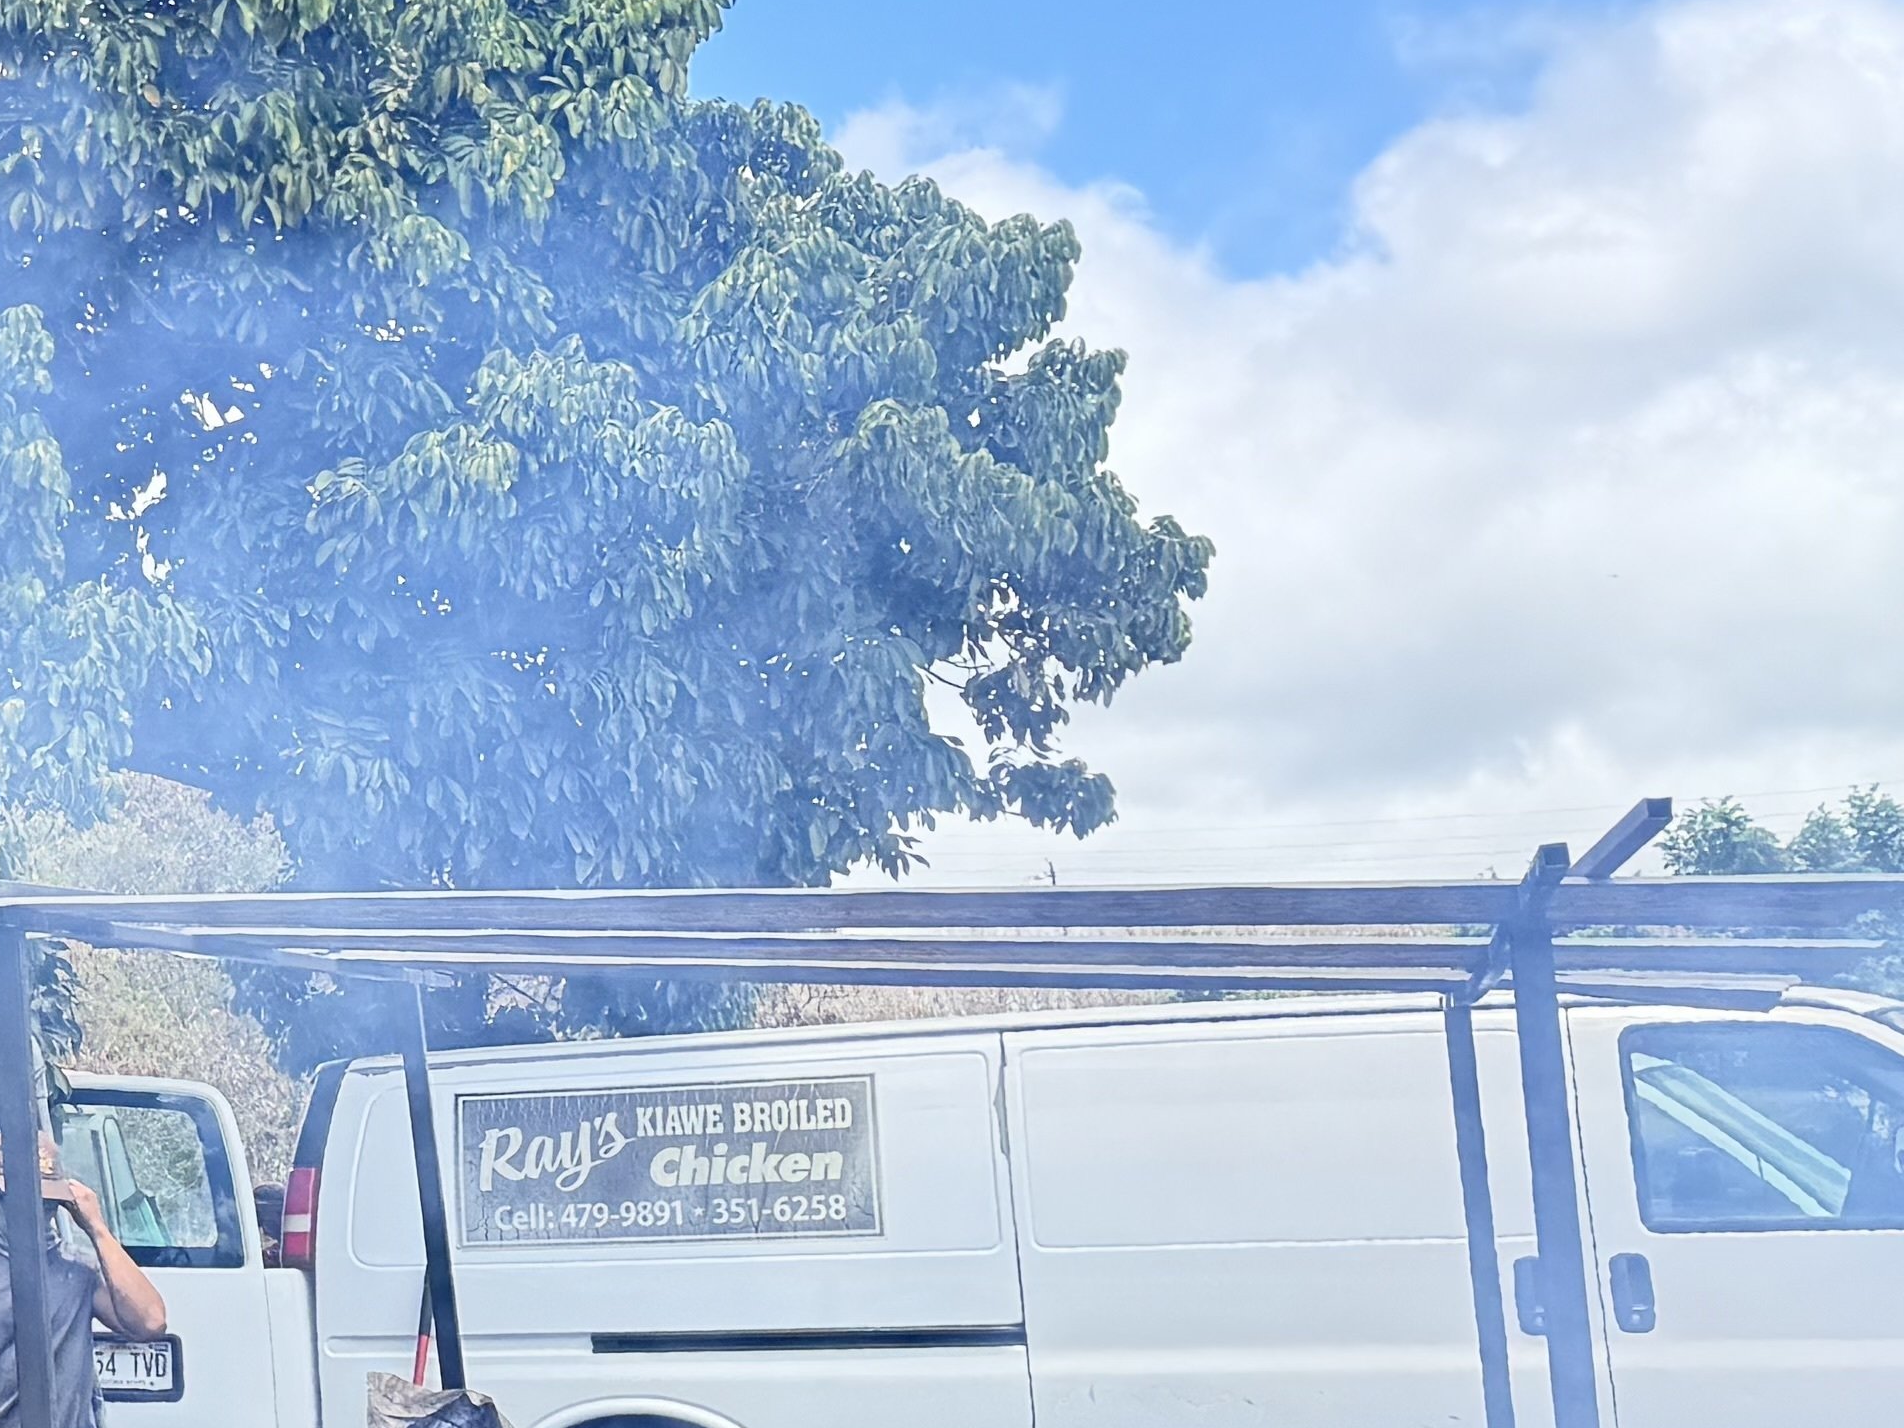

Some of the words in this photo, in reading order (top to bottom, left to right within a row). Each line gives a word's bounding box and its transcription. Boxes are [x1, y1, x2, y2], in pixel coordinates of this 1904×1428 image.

[636, 1104, 724, 1137] KIAWE
[732, 1098, 853, 1134] BROILED
[478, 1111, 636, 1192] Ray's
[649, 1142, 844, 1188] Chicken
[494, 1203, 554, 1232] Cell:
[561, 1200, 684, 1229] 479-9891
[712, 1194, 847, 1225] 351-6258
[94, 1352, 117, 1376] 54
[129, 1351, 168, 1378] TVD
